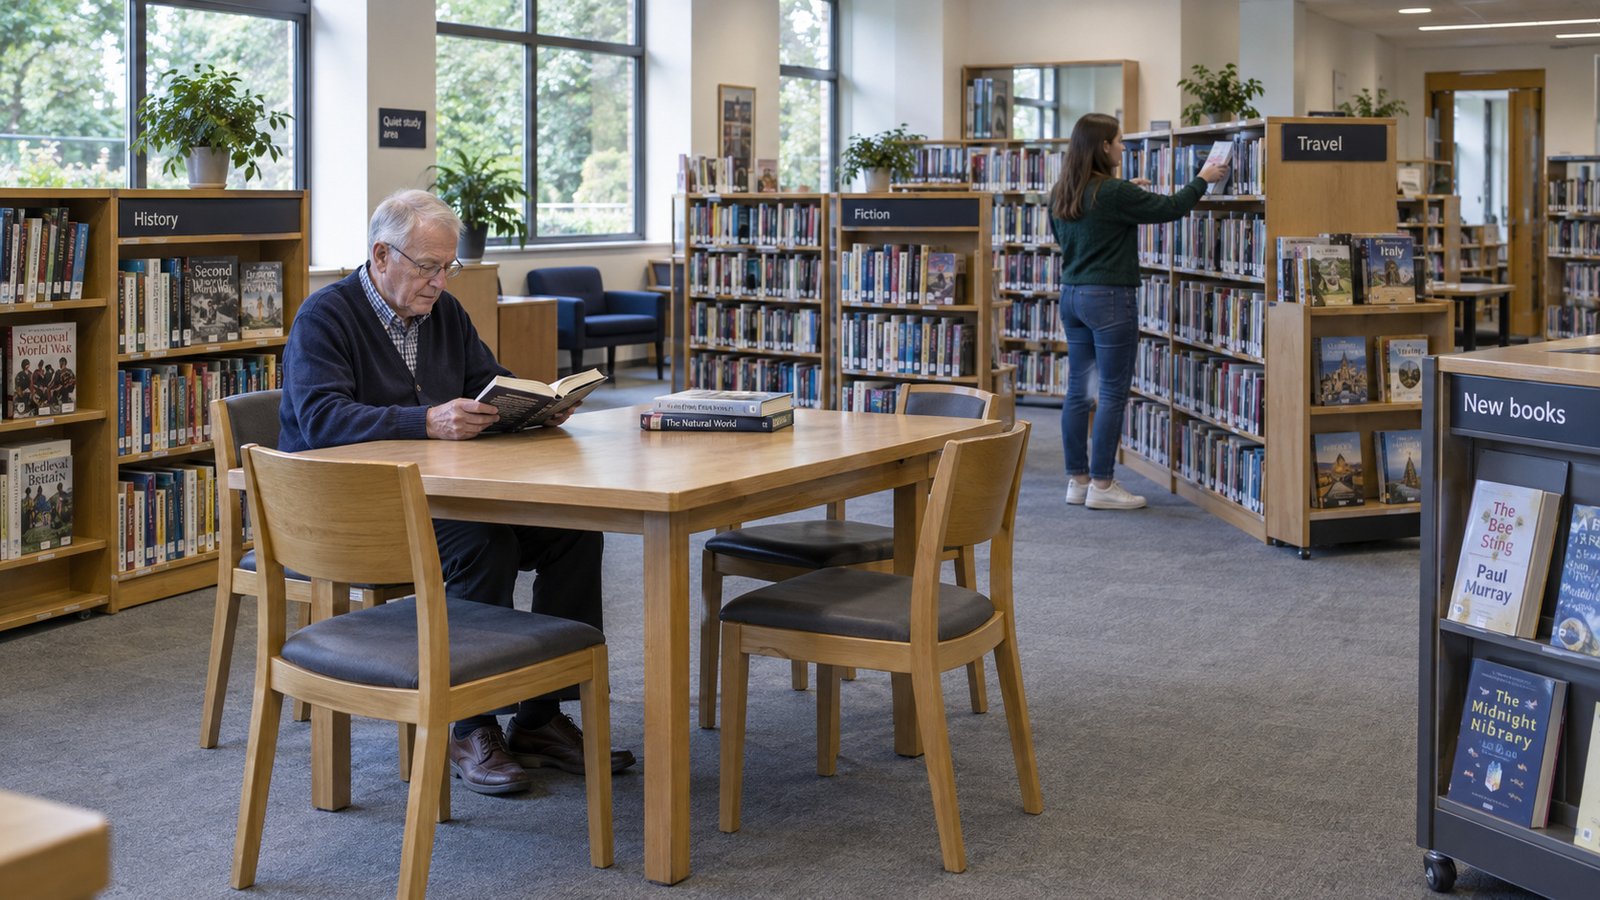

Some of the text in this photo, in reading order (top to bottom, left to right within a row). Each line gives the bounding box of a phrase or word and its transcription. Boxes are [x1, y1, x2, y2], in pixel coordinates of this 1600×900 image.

[383, 116, 421, 130] Quiet study
[383, 130, 399, 139] area
[1297, 136, 1342, 151] Travel
[134, 211, 178, 229] History
[854, 208, 890, 220] Fiction
[1380, 246, 1405, 259] Italy
[195, 263, 232, 277] Second
[17, 344, 48, 356] World
[1463, 392, 1566, 424] New books
[665, 418, 737, 429] The Natural World
[1494, 501, 1515, 518] The
[1488, 518, 1513, 535] Bee
[1481, 534, 1514, 556] Sting
[1477, 563, 1508, 584] Paul
[1464, 579, 1512, 606] Murray
[1496, 689, 1520, 707] The
[1471, 700, 1537, 731] Midnight
